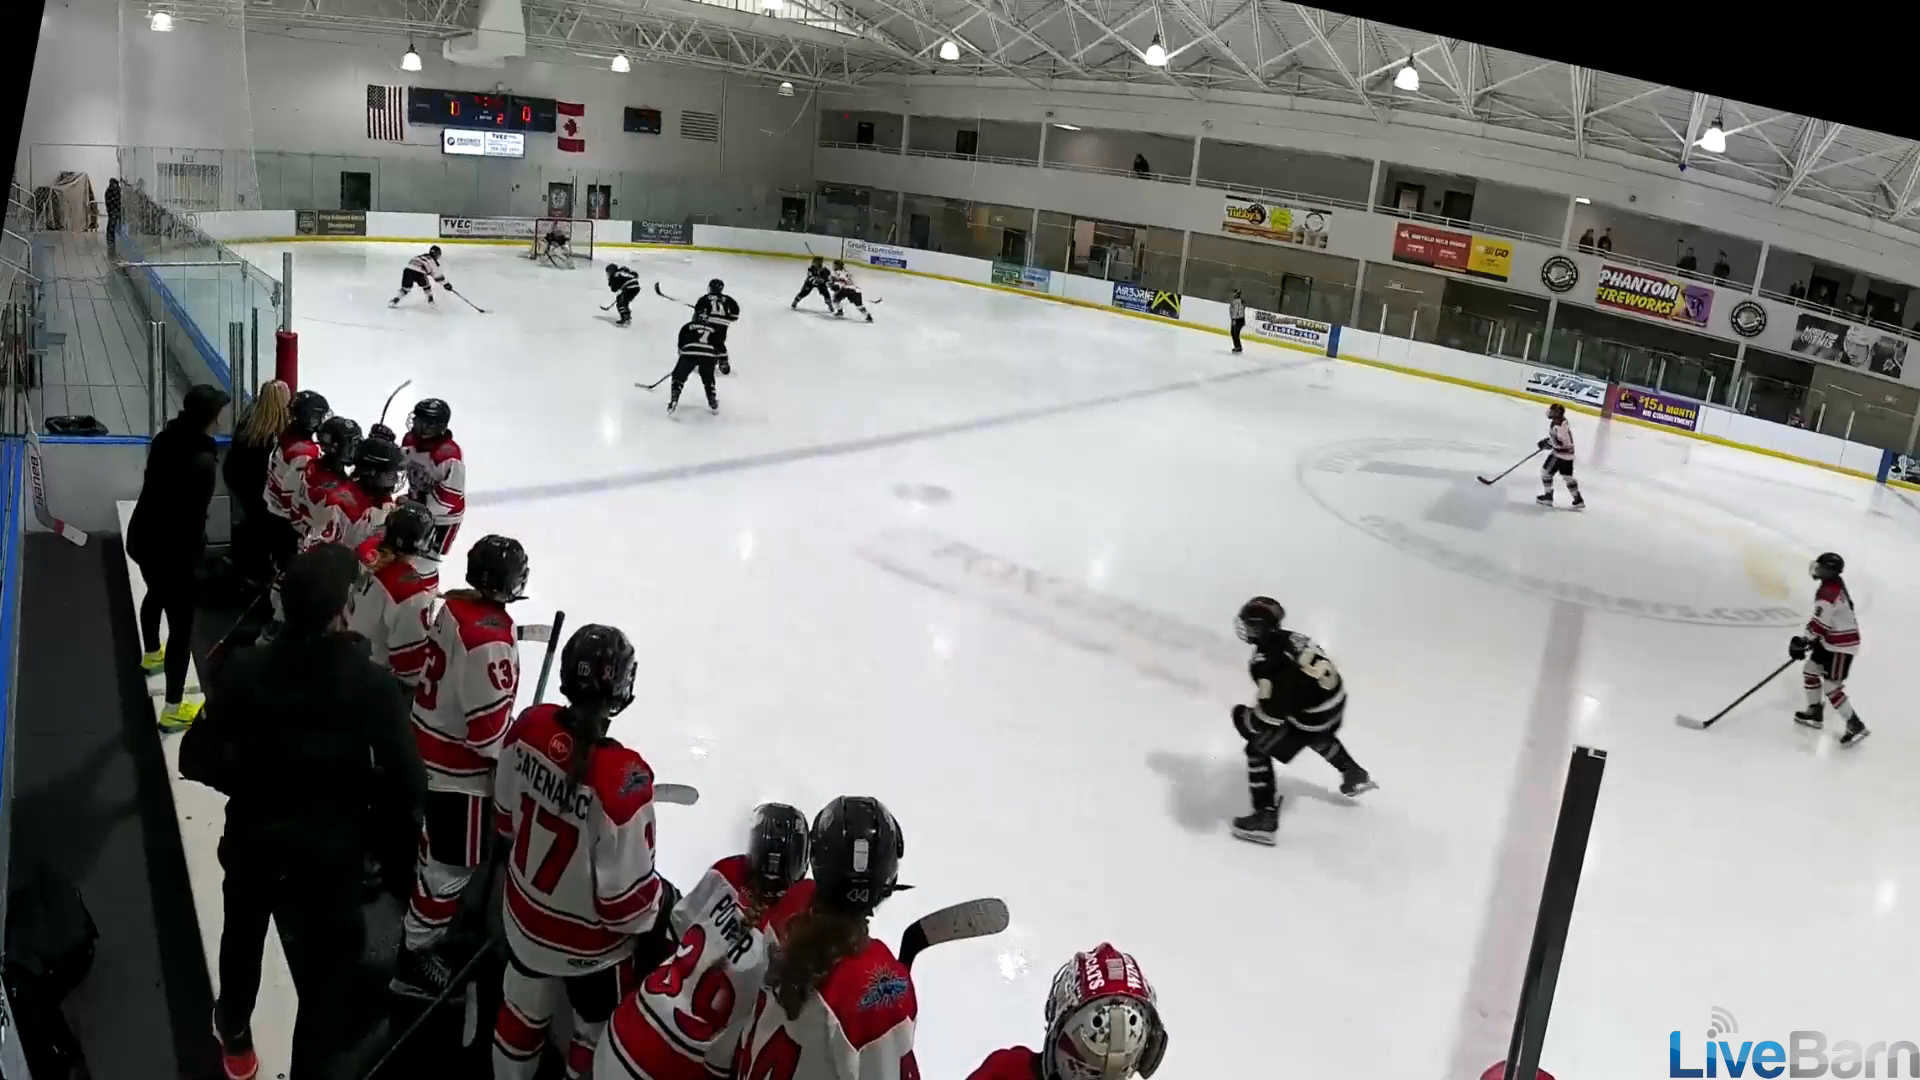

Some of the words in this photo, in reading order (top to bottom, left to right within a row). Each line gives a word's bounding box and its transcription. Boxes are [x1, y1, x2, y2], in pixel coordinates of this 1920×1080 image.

[443, 219, 471, 229] TVEC
[1494, 247, 1510, 258] GO
[1115, 285, 1155, 301] AIRBORNE
[1600, 269, 1679, 300] PHANTOM
[1597, 287, 1674, 315] FIREWORKS
[697, 329, 710, 343] 7
[1810, 335, 1836, 349] THIS
[1527, 370, 1606, 399] SKATE
[1639, 395, 1658, 411] $15
[1665, 404, 1697, 421] MONTH
[488, 659, 513, 691] 63
[515, 792, 579, 896] 17
